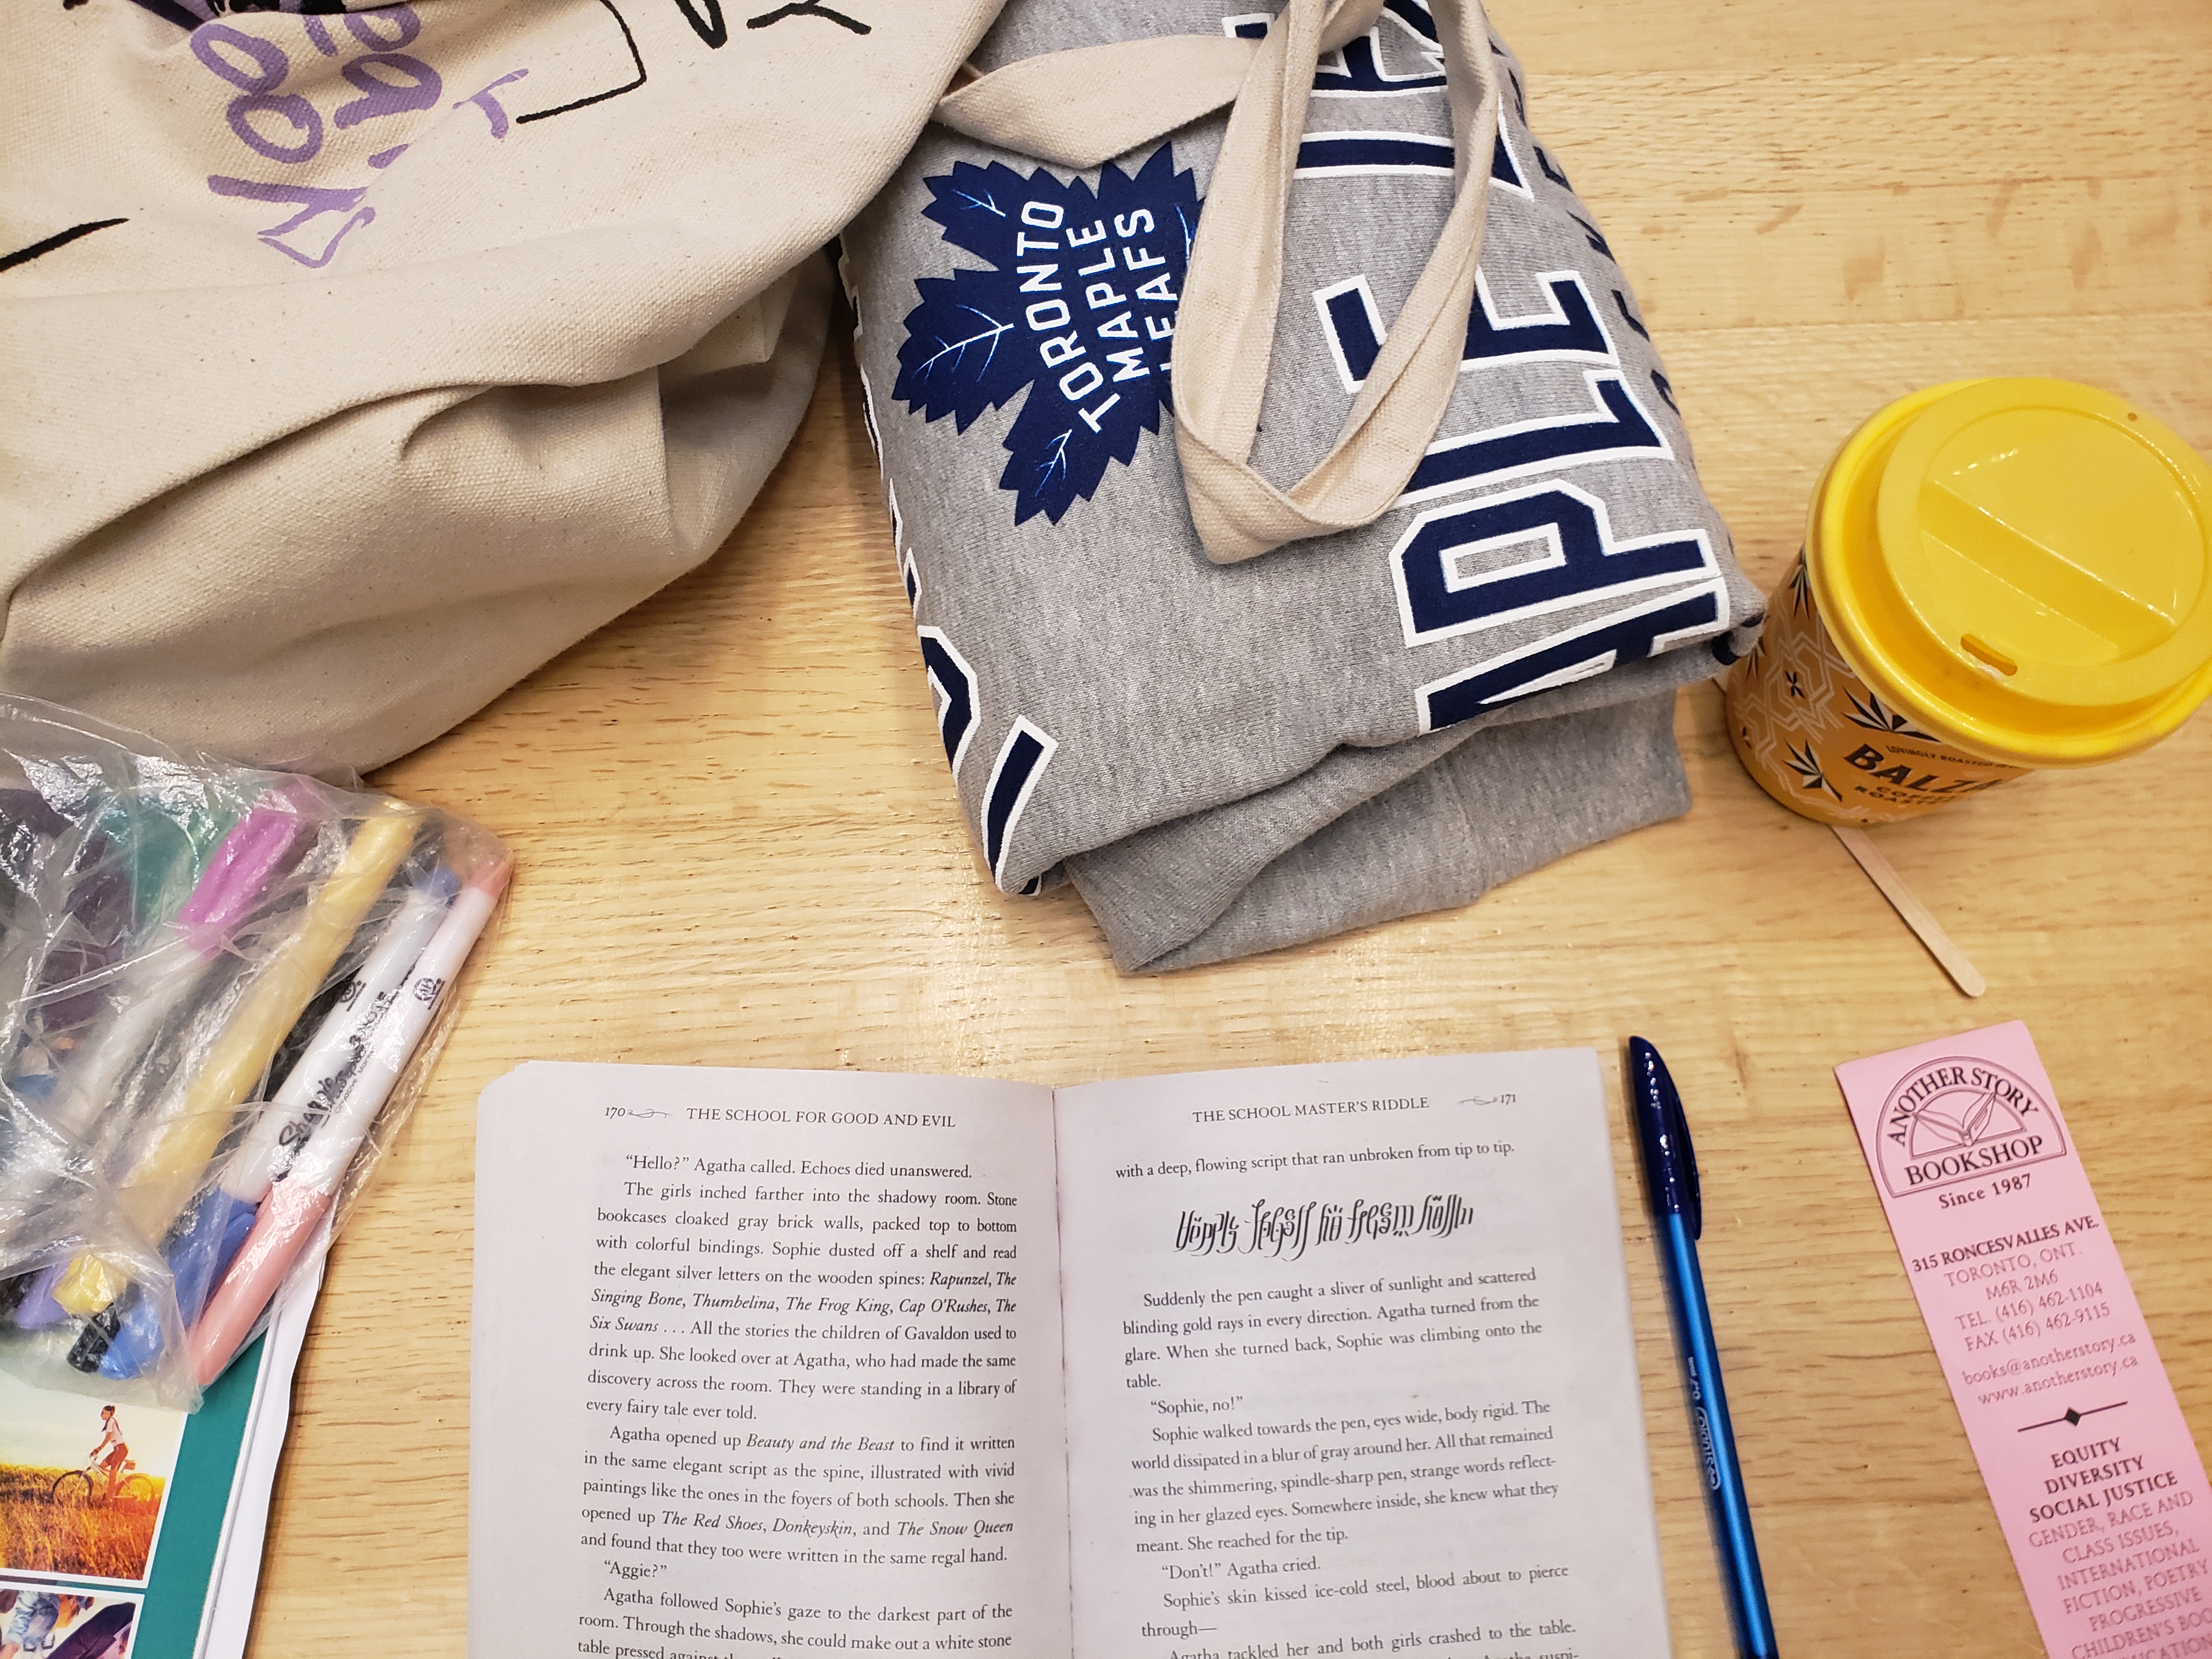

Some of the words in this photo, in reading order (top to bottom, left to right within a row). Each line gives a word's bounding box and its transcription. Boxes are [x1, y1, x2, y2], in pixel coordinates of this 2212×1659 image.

[1065, 219, 1150, 383] MAPLE
[1114, 208, 1178, 373] EAFS
[1016, 201, 1121, 434] TORONTO
[604, 1106, 627, 1119] 170
[686, 1107, 721, 1121] THE
[725, 1108, 792, 1123] SCHOOL
[795, 1110, 827, 1124] FOR
[831, 1111, 879, 1125] GOOD
[883, 1113, 918, 1126] AND
[922, 1114, 956, 1128] EVIL
[1192, 1109, 1226, 1124] THE
[1228, 1105, 1291, 1121] SCHOOL
[1294, 1101, 1369, 1116] MASTER'S
[1372, 1096, 1430, 1111] RIDDLE
[1499, 1093, 1516, 1105] 171
[1886, 1066, 1968, 1147] ANOTHER
[1970, 1067, 2039, 1119] STORY
[1115, 1163, 1144, 1178] with
[1146, 1166, 1155, 1176] a
[1157, 1160, 1192, 1178] deep,
[1195, 1156, 1248, 1174] flowing
[1250, 1154, 1289, 1171] script
[1291, 1152, 1319, 1166] that
[1322, 1154, 1346, 1165] ran
[1348, 1146, 1414, 1163] unbroken
[1417, 1143, 1451, 1159] from
[1454, 1142, 1474, 1160] tip
[1476, 1144, 1490, 1155] to
[1493, 1140, 1515, 1158] tip.
[1904, 1135, 2043, 1186] BOOKSHOP
[623, 1181, 653, 1197] The
[660, 1183, 692, 1201] girls
[699, 1184, 747, 1200] inched
[755, 1185, 805, 1201] farther
[812, 1187, 840, 1203] into
[848, 1188, 871, 1203] the
[877, 1188, 938, 1209] shadowy
[944, 1195, 981, 1206] room.
[986, 1191, 1018, 1207] Stone
[1938, 1189, 1986, 1210] Since
[1991, 1172, 2031, 1196] 1987
[597, 1206, 667, 1224] bookcases
[674, 1210, 729, 1227] cloaked
[737, 1217, 770, 1232] gray
[777, 1213, 814, 1229] brick
[823, 1214, 864, 1233] walls,
[872, 1216, 921, 1235] packed
[928, 1220, 950, 1237] top
[957, 1221, 970, 1232] to
[977, 1217, 1018, 1233] bottom
[1911, 1254, 1939, 1273] 315
[1940, 1223, 2061, 1266] RONCESVALLES
[2064, 1215, 2100, 1235] AVE.
[595, 1234, 628, 1249] with
[635, 1235, 690, 1252] colorful
[698, 1238, 764, 1259] bindings.
[771, 1240, 821, 1260] Sophie
[828, 1242, 876, 1257] dusted
[883, 1243, 906, 1258] off
[910, 1248, 918, 1259] a
[924, 1243, 959, 1259] shelf
[962, 1244, 986, 1259] and
[992, 1244, 1017, 1260] read
[1943, 1254, 2037, 1288] TORONTO,
[2039, 1241, 2083, 1263] ONT.
[1143, 1289, 1206, 1308] Suddenly
[1210, 1288, 1233, 1304] the
[1237, 1291, 1263, 1306] pen
[1267, 1283, 1314, 1303] caught
[1317, 1287, 1326, 1297] a
[1330, 1280, 1365, 1296] sliver
[1369, 1277, 1385, 1293] of
[1388, 1274, 1443, 1294] sunlight
[1447, 1271, 1474, 1288] and
[1477, 1266, 1537, 1285] scattered
[1954, 1310, 1991, 1330] TEL.
[1995, 1299, 2034, 1323] (416)
[2038, 1281, 2103, 1309] 462-1104
[1985, 1279, 2022, 1301] M6R
[2023, 1268, 2059, 1290] 2M6
[1964, 1330, 1999, 1352] FAX
[2001, 1320, 2041, 1345] (416)
[2045, 1301, 2111, 1330] 462-9115
[1126, 1373, 1161, 1389] table.
[1961, 1333, 2137, 1385] books@anotherstory.ca
[1977, 1356, 2139, 1405] www.anotherstory.ca
[585, 1401, 623, 1417] every
[627, 1398, 660, 1419] fairy
[663, 1401, 689, 1417] tale
[692, 1407, 722, 1418] ever
[726, 1404, 758, 1420] told.
[1131, 1453, 1170, 1470] world
[1172, 1449, 1240, 1471] dissipated
[1243, 1449, 1259, 1465] in
[1260, 1453, 1269, 1464] a
[1271, 1447, 1301, 1463] blur
[1302, 1444, 1319, 1460] of
[1320, 1447, 1350, 1463] gray
[1353, 1437, 1403, 1457] around
[1404, 1436, 1432, 1452] her.
[1434, 1433, 1457, 1450] All
[1459, 1432, 1487, 1448] that
[1489, 1425, 1554, 1444] remained
[2050, 1437, 2120, 1469] EQUITY
[2029, 1493, 2101, 1523] SOCIAL
[2102, 1470, 2179, 1508] JUSTICE
[2044, 1455, 2143, 1495] DIVERSITY
[1136, 1541, 1184, 1553] meant.
[1187, 1535, 1213, 1551] She
[1217, 1530, 1271, 1549] reached
[1276, 1529, 1296, 1545] for
[1299, 1527, 1322, 1543] the
[1325, 1526, 1349, 1545] tip.
[2028, 1516, 2105, 1548] GENDER,
[2106, 1502, 2153, 1528] RACE
[2158, 1490, 2194, 1515] AND
[580, 1532, 607, 1547] and
[611, 1532, 652, 1551] found
[656, 1537, 684, 1553] that
[687, 1539, 718, 1560] they
[721, 1545, 744, 1558] too
[748, 1549, 782, 1560] were
[786, 1547, 839, 1563] written
[843, 1549, 858, 1564] in
[862, 1548, 886, 1565] the
[889, 1554, 927, 1565] same
[931, 1548, 966, 1568] regal
[969, 1545, 1008, 1563] hand.
[2056, 1537, 2200, 1591] INTERNATIONAL
[2062, 1537, 2115, 1564] CLASS
[2117, 1520, 2179, 1550] ISSUES,
[2062, 1579, 2142, 1615] FICTION,
[2143, 1558, 2208, 1592] POETRY
[2088, 1585, 2203, 1633] PROGRESSIVE
[2177, 1608, 2212, 1631] BOO
